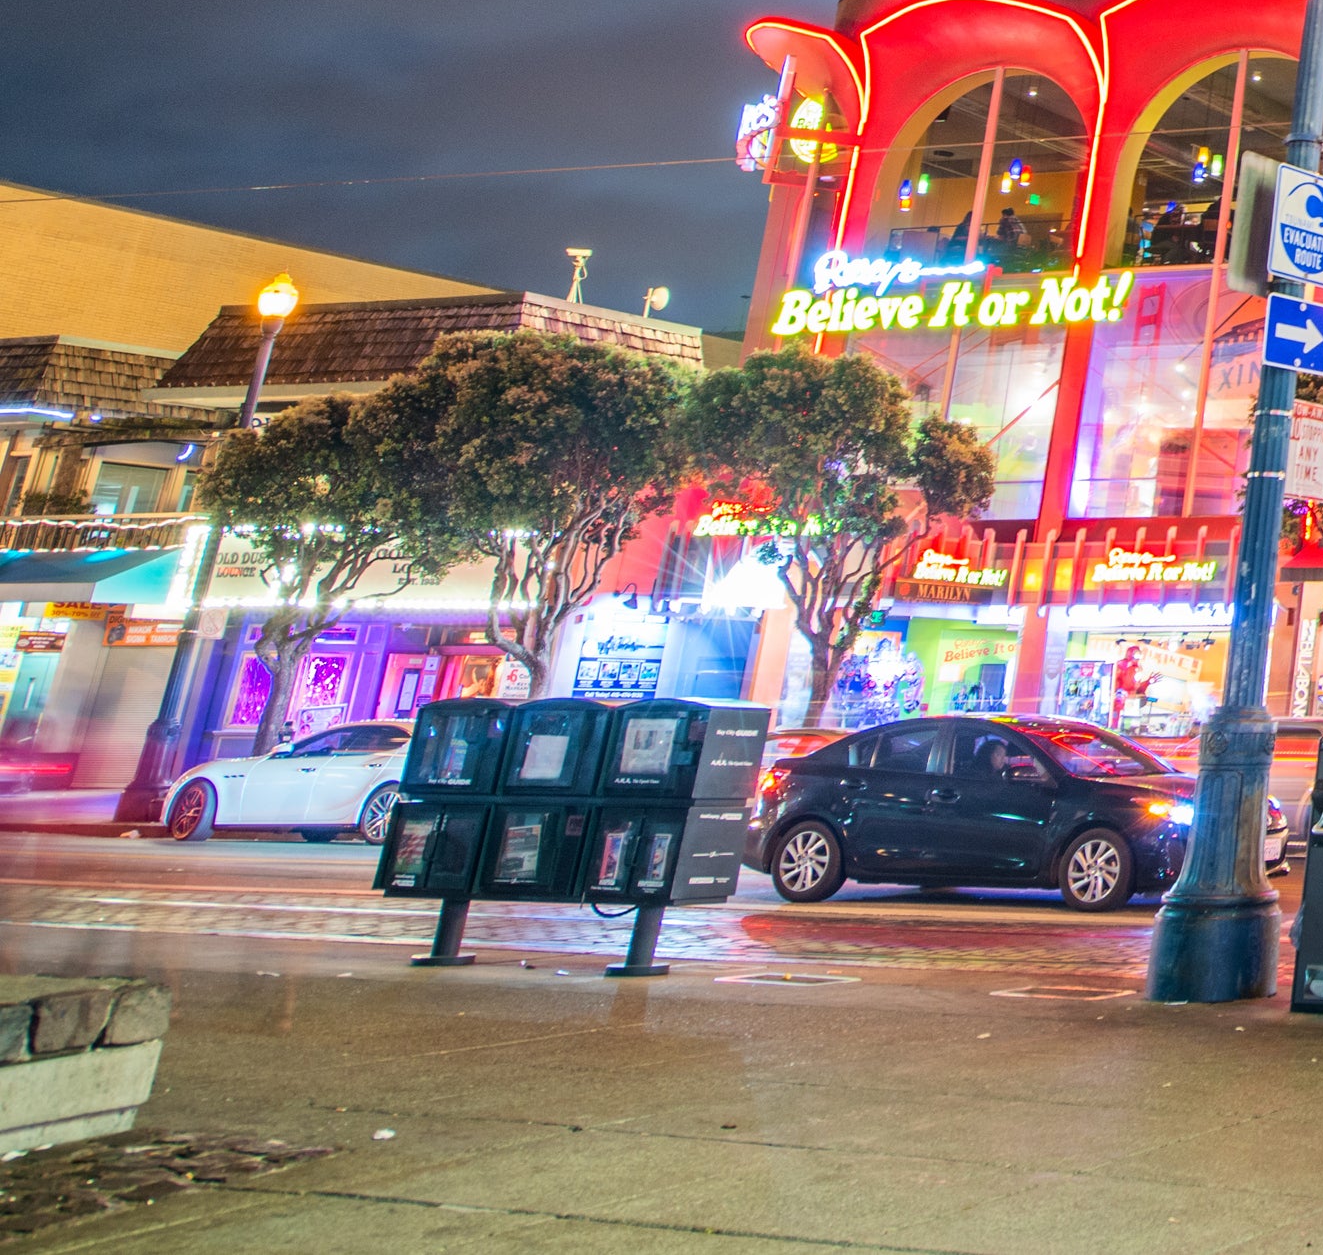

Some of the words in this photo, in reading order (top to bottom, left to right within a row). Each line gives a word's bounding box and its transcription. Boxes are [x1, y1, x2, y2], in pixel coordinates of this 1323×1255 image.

[1294, 248, 1323, 270] ROUTE
[771, 290, 924, 336] Believe
[928, 281, 975, 328] It
[977, 289, 1030, 327] or
[1029, 271, 1135, 324] Not!
[1299, 445, 1318, 462] ANY
[1295, 463, 1318, 482] TIME
[216, 567, 256, 578] LOUNGE
[918, 584, 971, 600] MARILYN
[944, 647, 989, 663] Believe
[994, 642, 1005, 655] It
